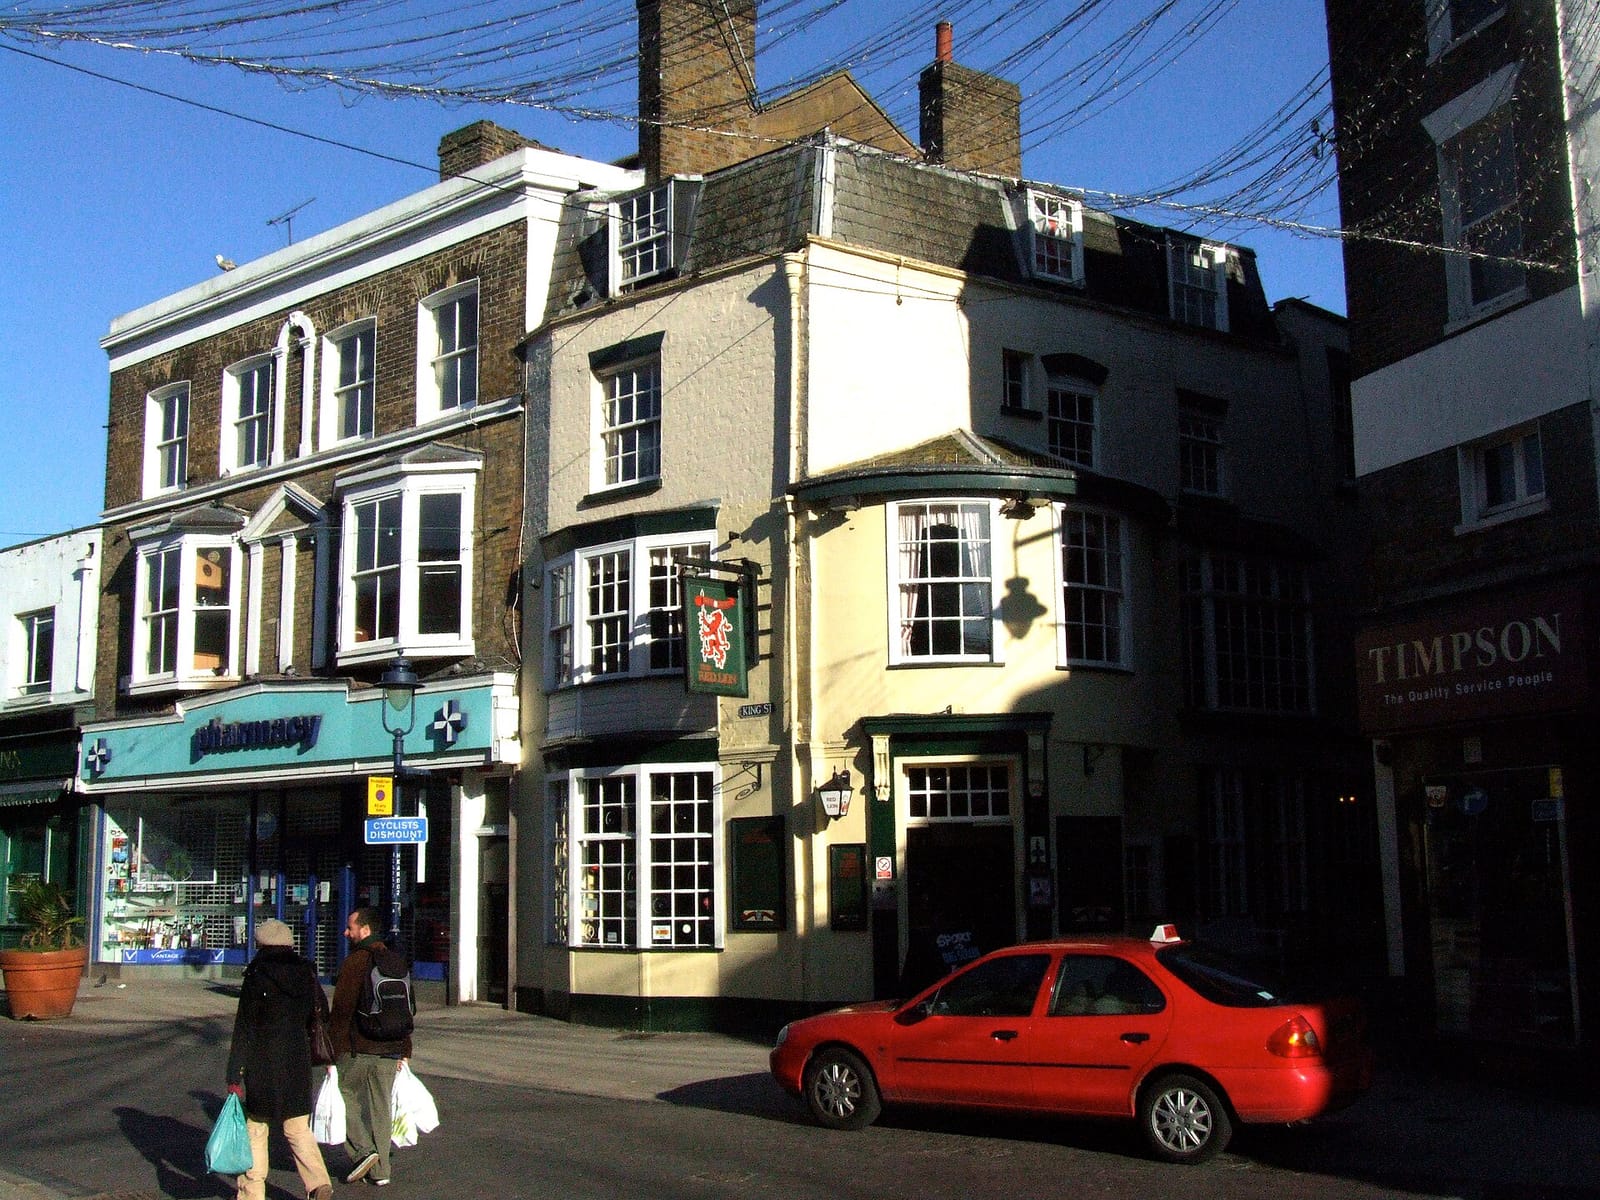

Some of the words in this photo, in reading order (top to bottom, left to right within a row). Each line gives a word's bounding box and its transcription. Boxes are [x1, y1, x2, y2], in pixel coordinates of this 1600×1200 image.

[1368, 613, 1561, 684] TIMPSON
[699, 671, 717, 683] RED
[1384, 694, 1403, 705] The
[1408, 687, 1450, 702] Quality
[1455, 679, 1501, 695] Service
[1508, 671, 1552, 689] People
[742, 705, 761, 716] KING
[191, 716, 321, 763] pharmacy
[373, 821, 419, 830] CYCLISTS
[370, 830, 423, 839] DISMOUNT
[151, 950, 179, 960] VANTAGE
